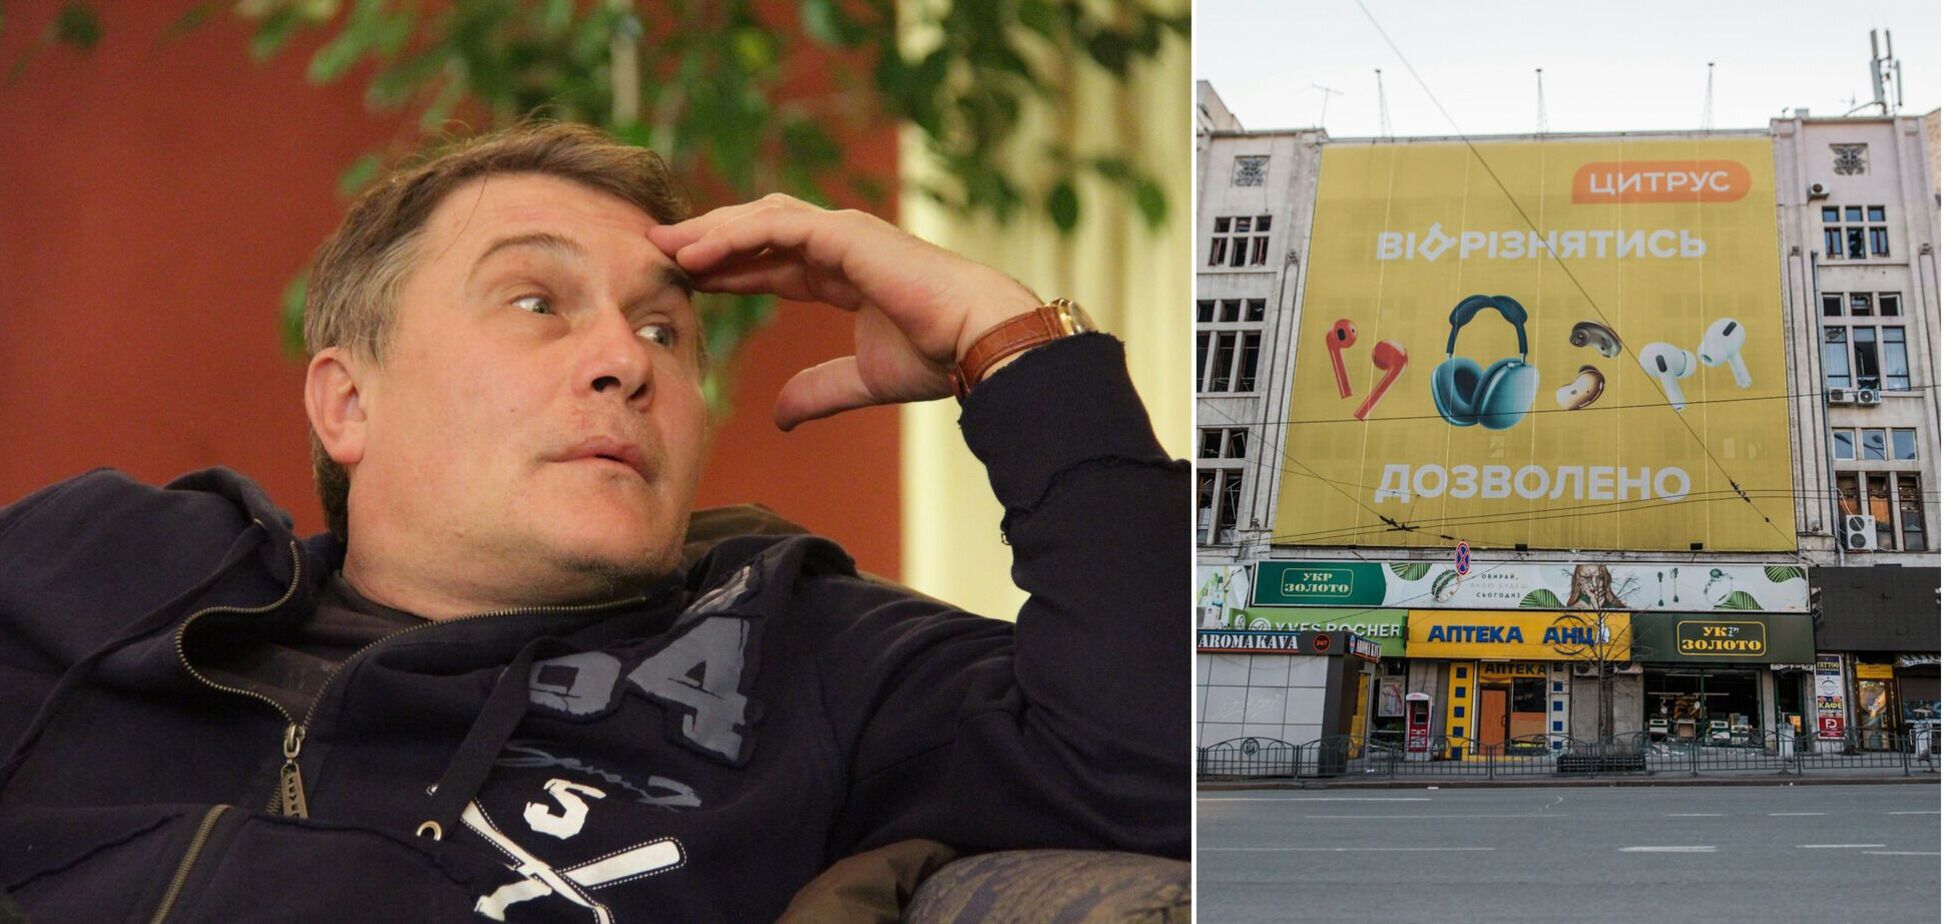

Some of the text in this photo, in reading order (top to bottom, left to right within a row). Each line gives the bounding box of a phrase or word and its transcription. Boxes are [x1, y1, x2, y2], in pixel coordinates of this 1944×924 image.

[1589, 170, 1730, 196] ЦИТРУС
[1373, 463, 1691, 504] ДОЗВОЛЕНО
[1303, 572, 1333, 582] УКР
[1284, 583, 1350, 593] ЗОЛОТО
[1326, 623, 1400, 637] ROCHER
[1427, 624, 1524, 644] АПТЕКА
[1198, 633, 1298, 649] AROMA KAVA
[1681, 639, 1762, 651] ЗОЛОТО
[1485, 662, 1547, 675] АПТЕКА
